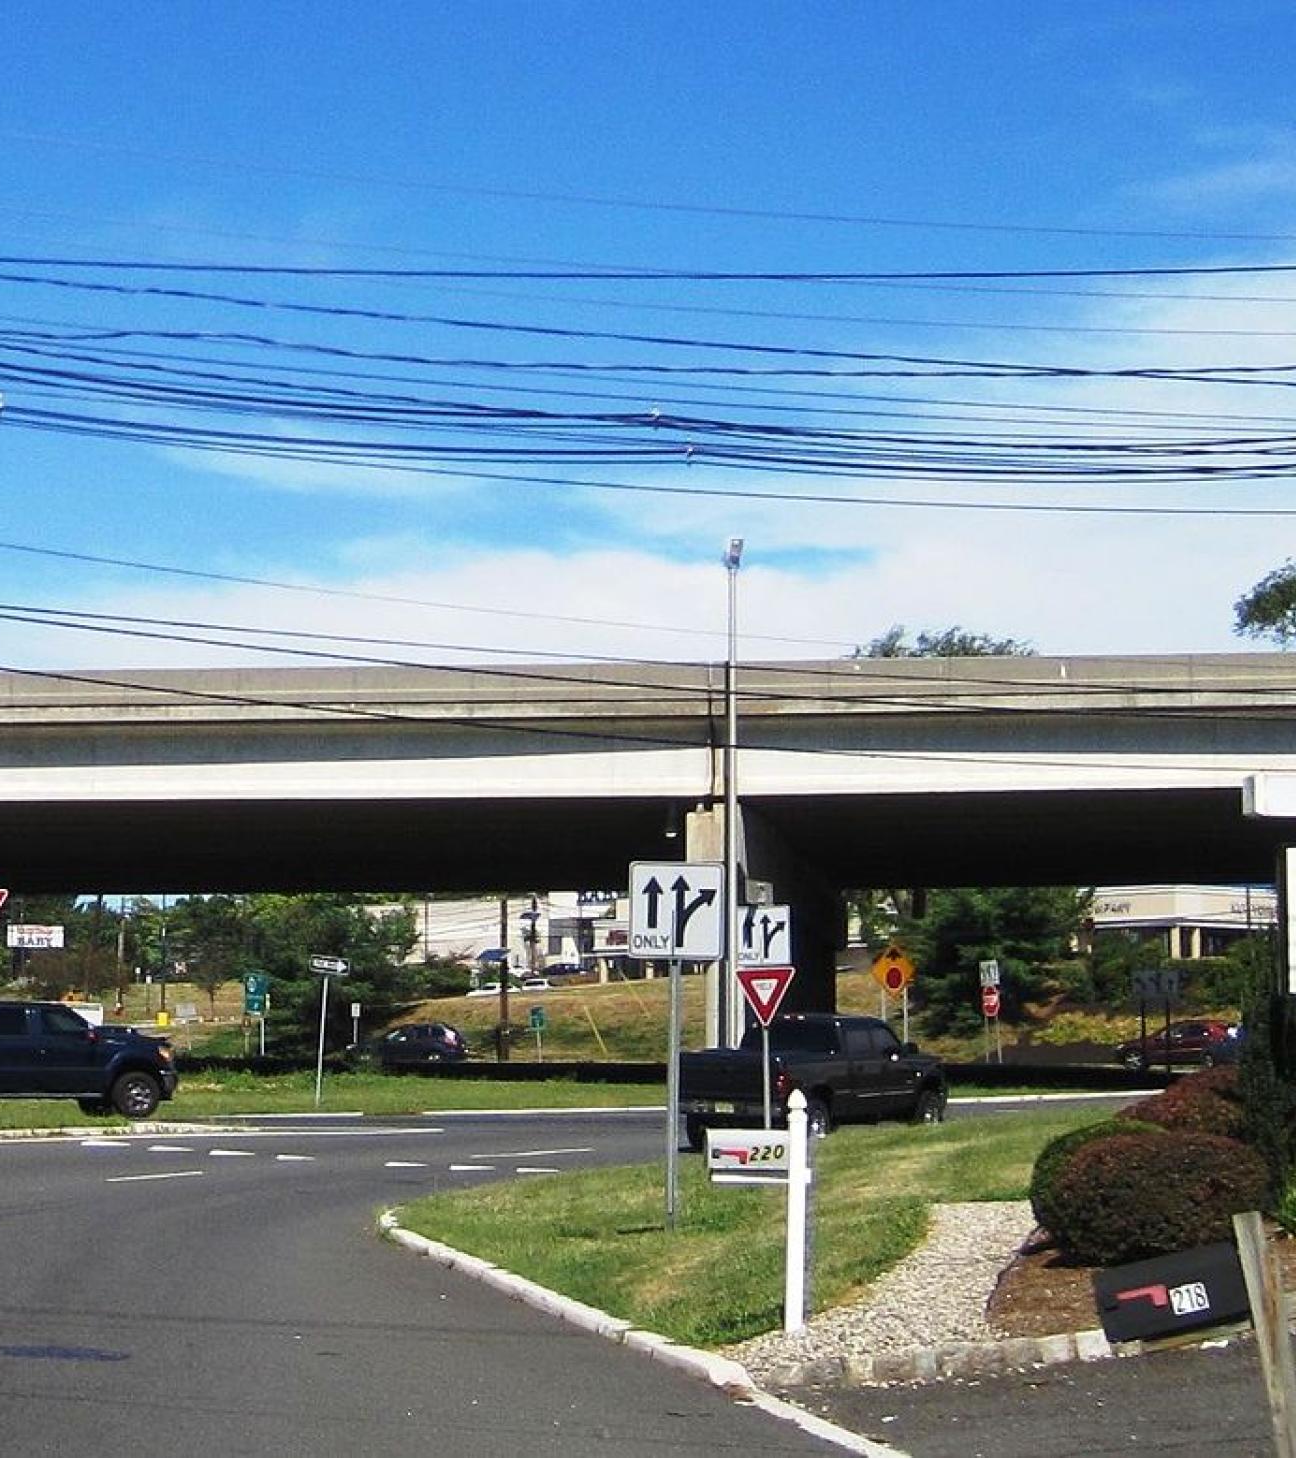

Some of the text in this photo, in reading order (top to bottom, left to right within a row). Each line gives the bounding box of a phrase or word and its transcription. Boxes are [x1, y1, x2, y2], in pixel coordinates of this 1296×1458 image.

[633, 934, 670, 949] ONLY
[738, 952, 760, 961] ONLY
[750, 1144, 784, 1161] 220
[1172, 1285, 1206, 1313] 218
